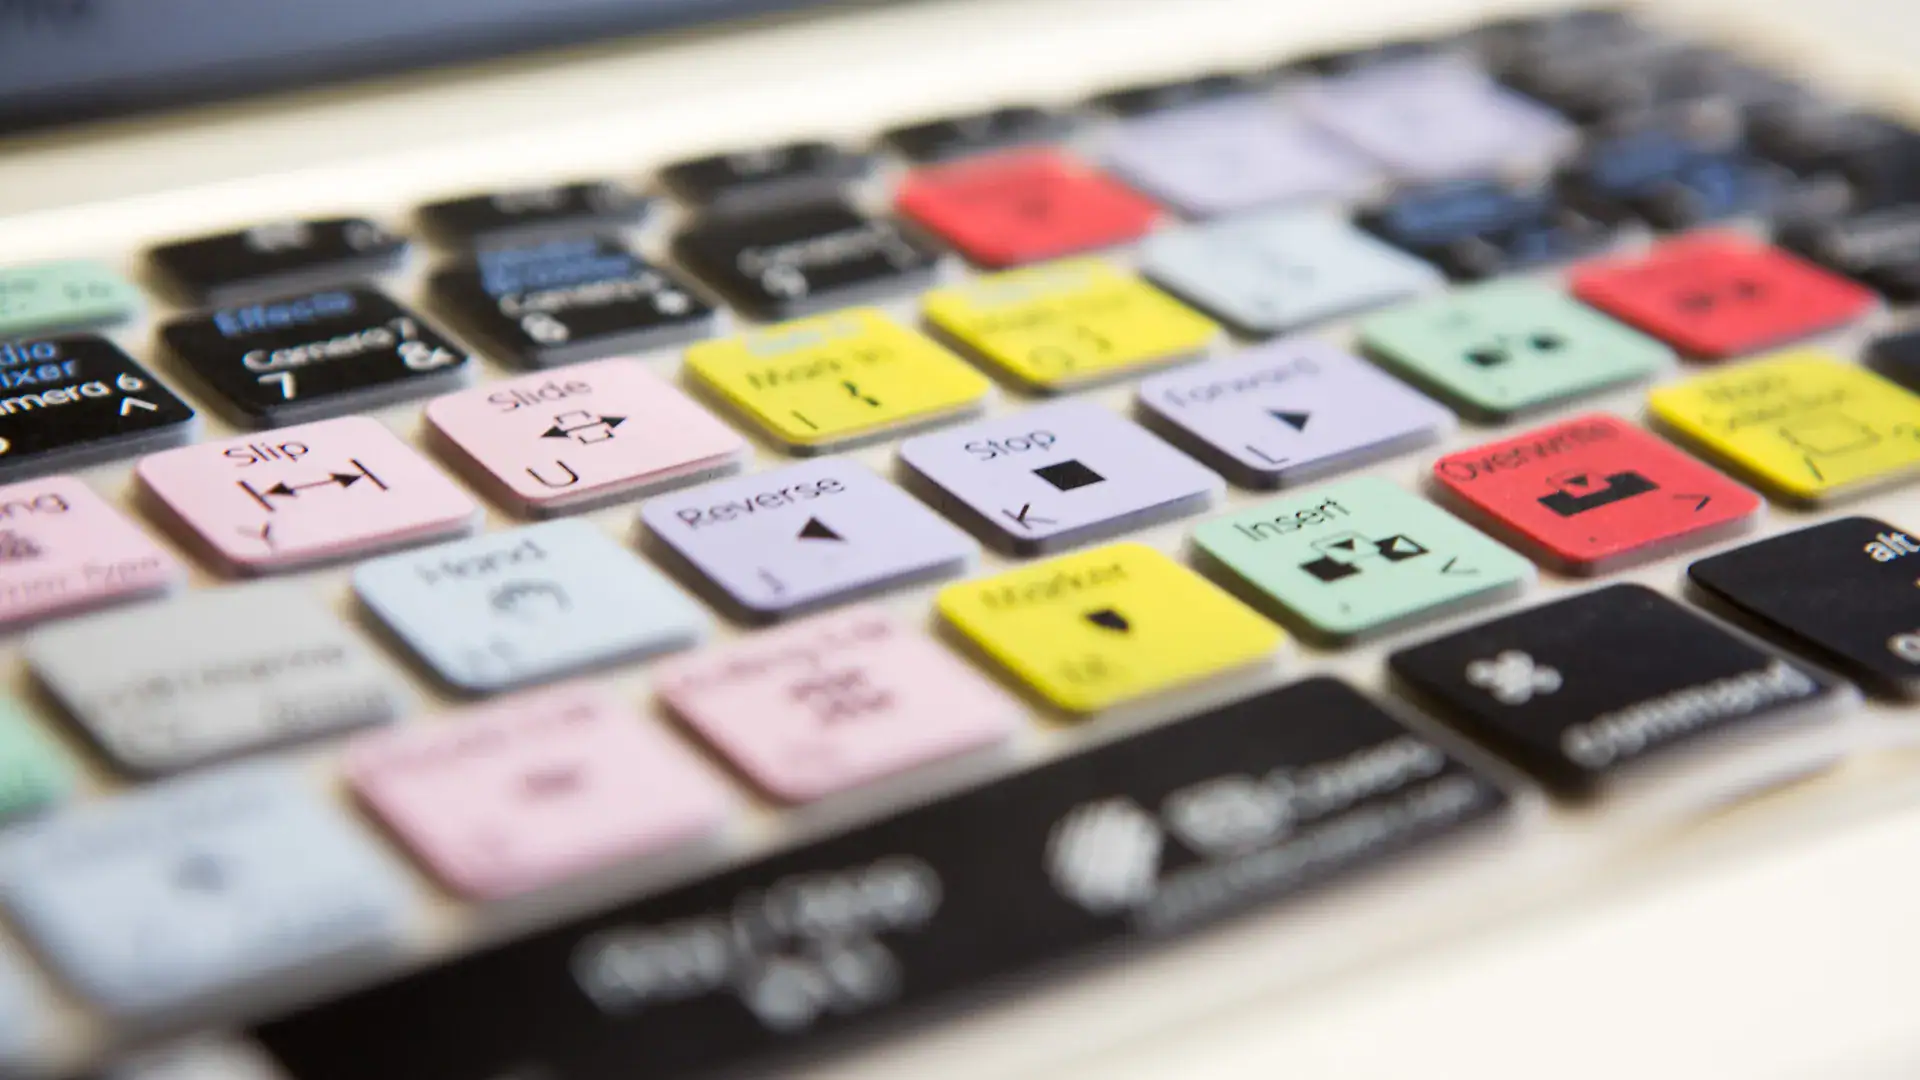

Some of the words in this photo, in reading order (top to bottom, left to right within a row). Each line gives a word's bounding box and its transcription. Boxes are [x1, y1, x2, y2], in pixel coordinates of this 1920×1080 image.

[242, 326, 394, 373] Camera
[116, 372, 146, 392] 6
[256, 371, 296, 400] 7
[486, 380, 593, 413] Slide
[1163, 355, 1320, 407] Forward
[223, 441, 310, 468] Slip
[964, 430, 1057, 462] Stop
[1245, 444, 1291, 465] L
[1440, 421, 1620, 482] Overwrite
[525, 458, 580, 489] U
[675, 478, 846, 529] Reverse
[1001, 502, 1058, 530] K
[1232, 497, 1352, 543] Insert
[235, 521, 277, 554] Y
[1862, 531, 1920, 563] alt
[413, 537, 549, 588] Hand
[977, 561, 1130, 612] Marker
[1563, 658, 1817, 766] command
